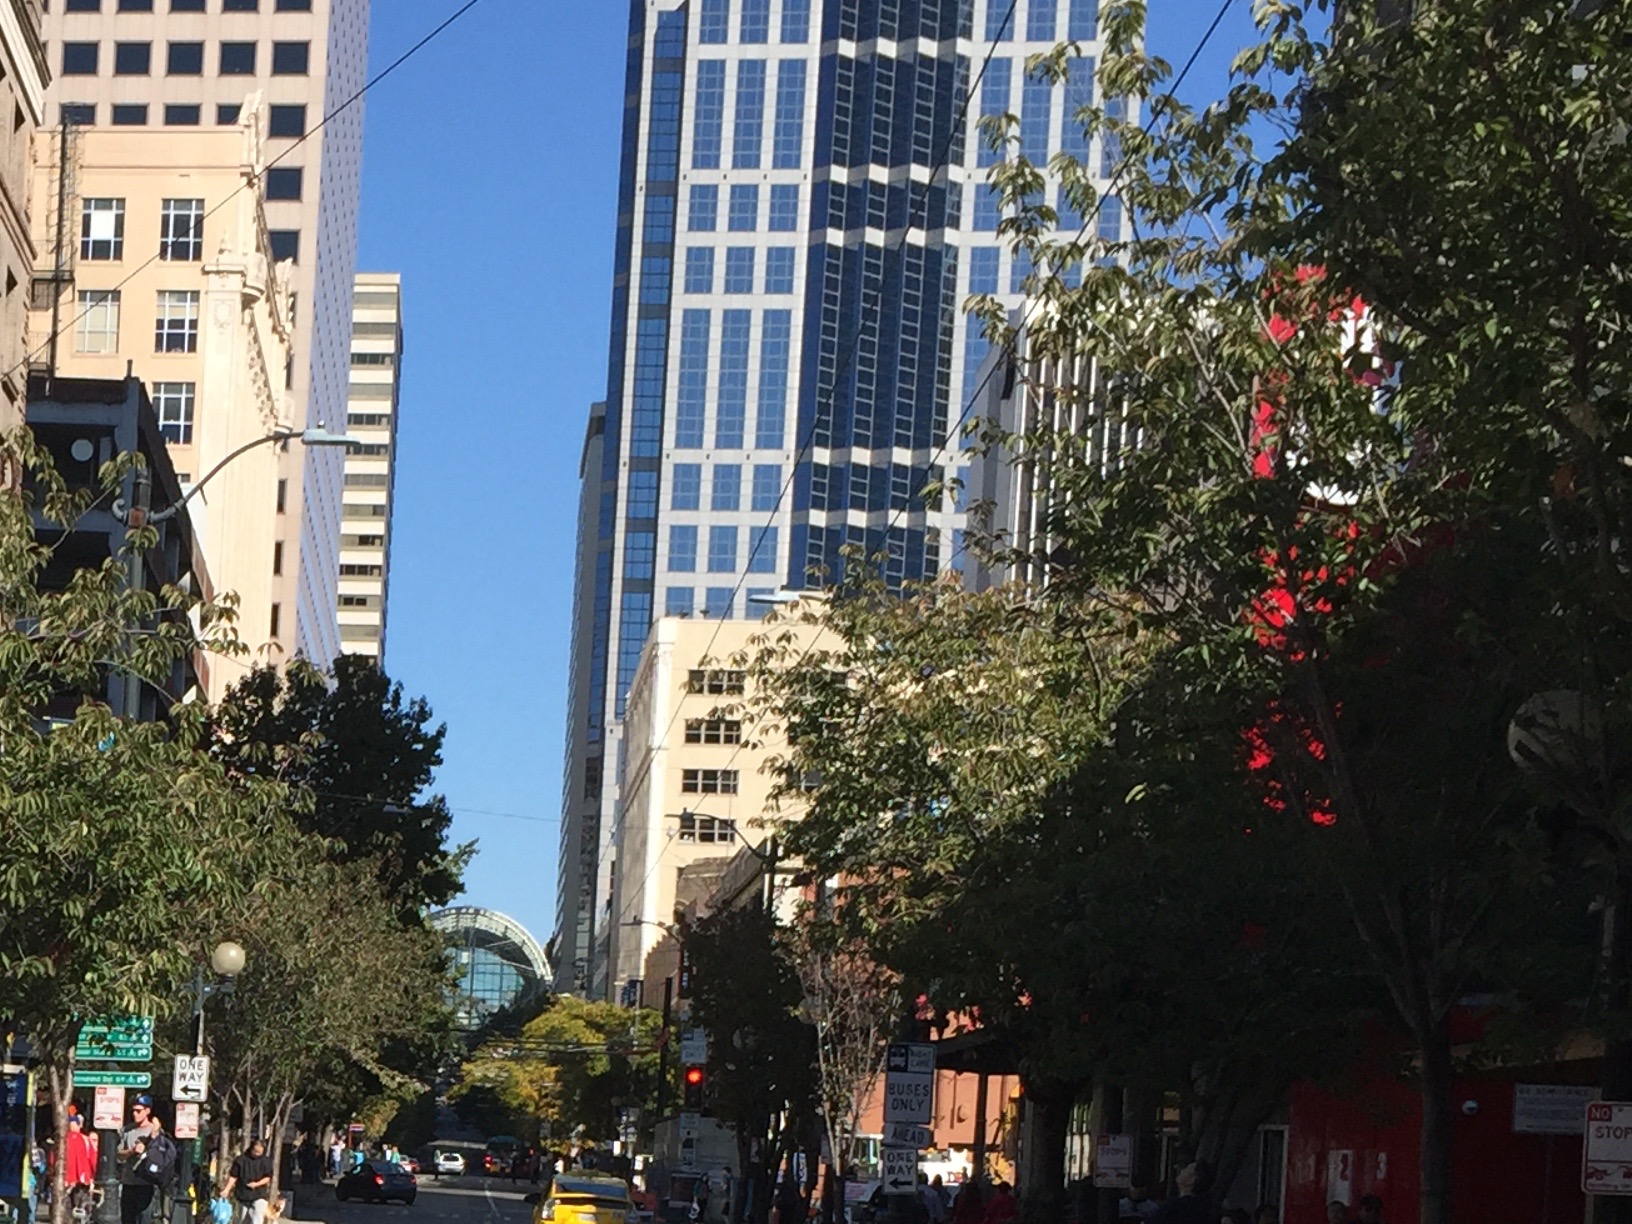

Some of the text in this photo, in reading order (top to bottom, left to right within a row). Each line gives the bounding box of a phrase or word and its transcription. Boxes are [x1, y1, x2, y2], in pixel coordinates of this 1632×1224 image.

[179, 1059, 204, 1071] ONE
[178, 1072, 204, 1084] WAY
[888, 1083, 930, 1097] BUSES
[891, 1098, 925, 1111] ONLY
[1590, 1106, 1611, 1120] NO
[892, 1127, 925, 1144] AHEAD
[886, 1151, 914, 1163] ONE
[886, 1164, 914, 1176] WAY
